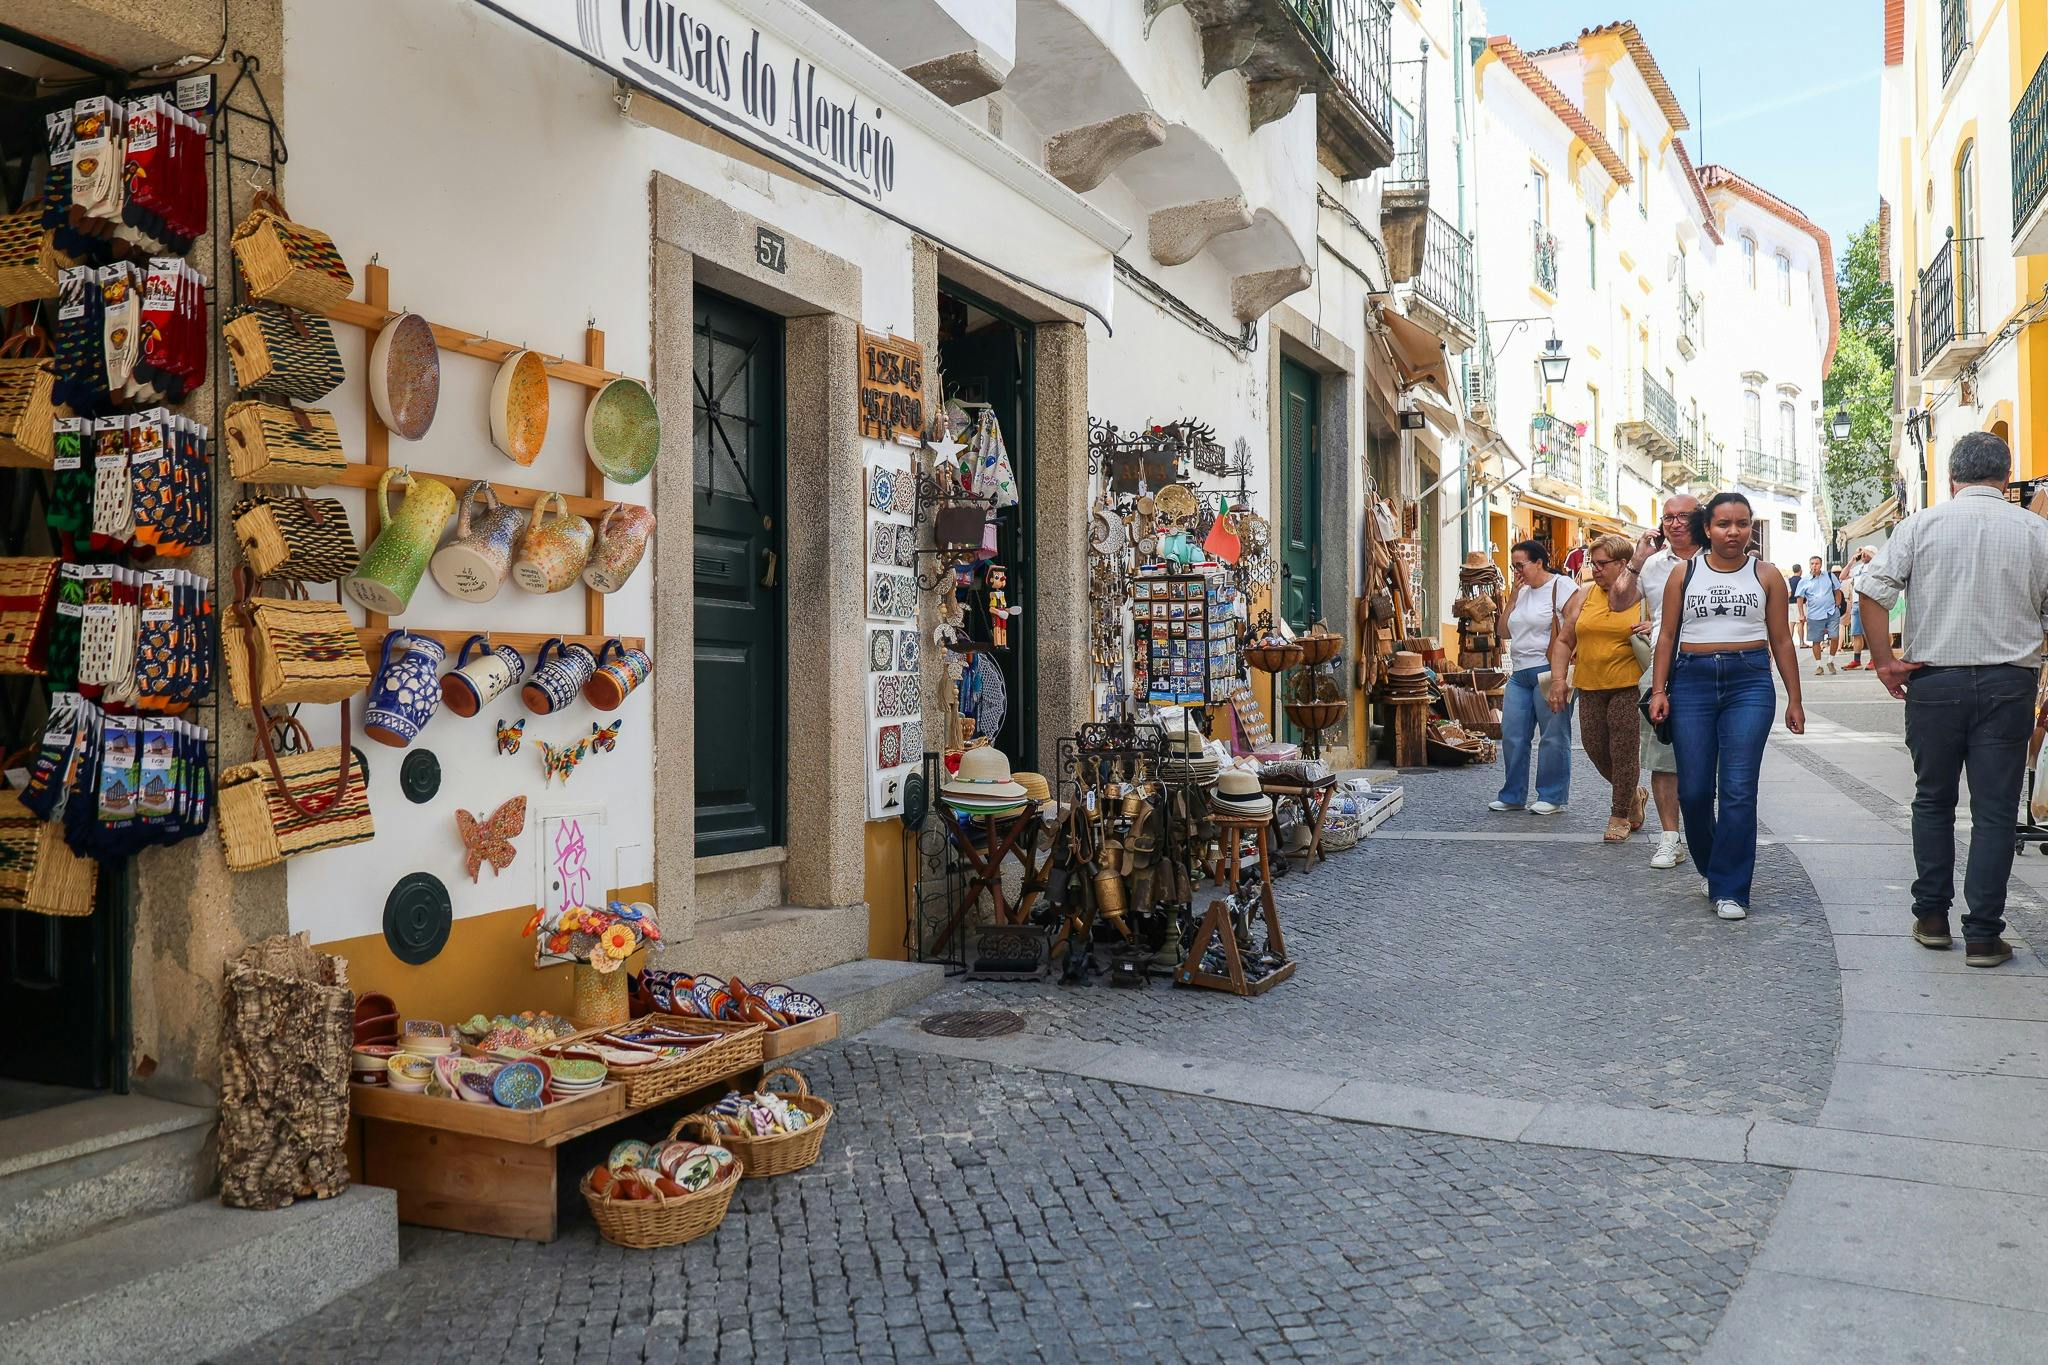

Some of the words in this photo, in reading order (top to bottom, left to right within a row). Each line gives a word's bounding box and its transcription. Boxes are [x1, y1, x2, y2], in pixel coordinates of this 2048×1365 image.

[741, 27, 777, 127] do
[787, 57, 895, 201] Alentejo
[760, 235, 782, 268] 57
[1686, 594, 1707, 611] NEW
[1710, 592, 1759, 609] ORLEANS
[1694, 606, 1708, 618] 19
[1733, 605, 1747, 617] 91
